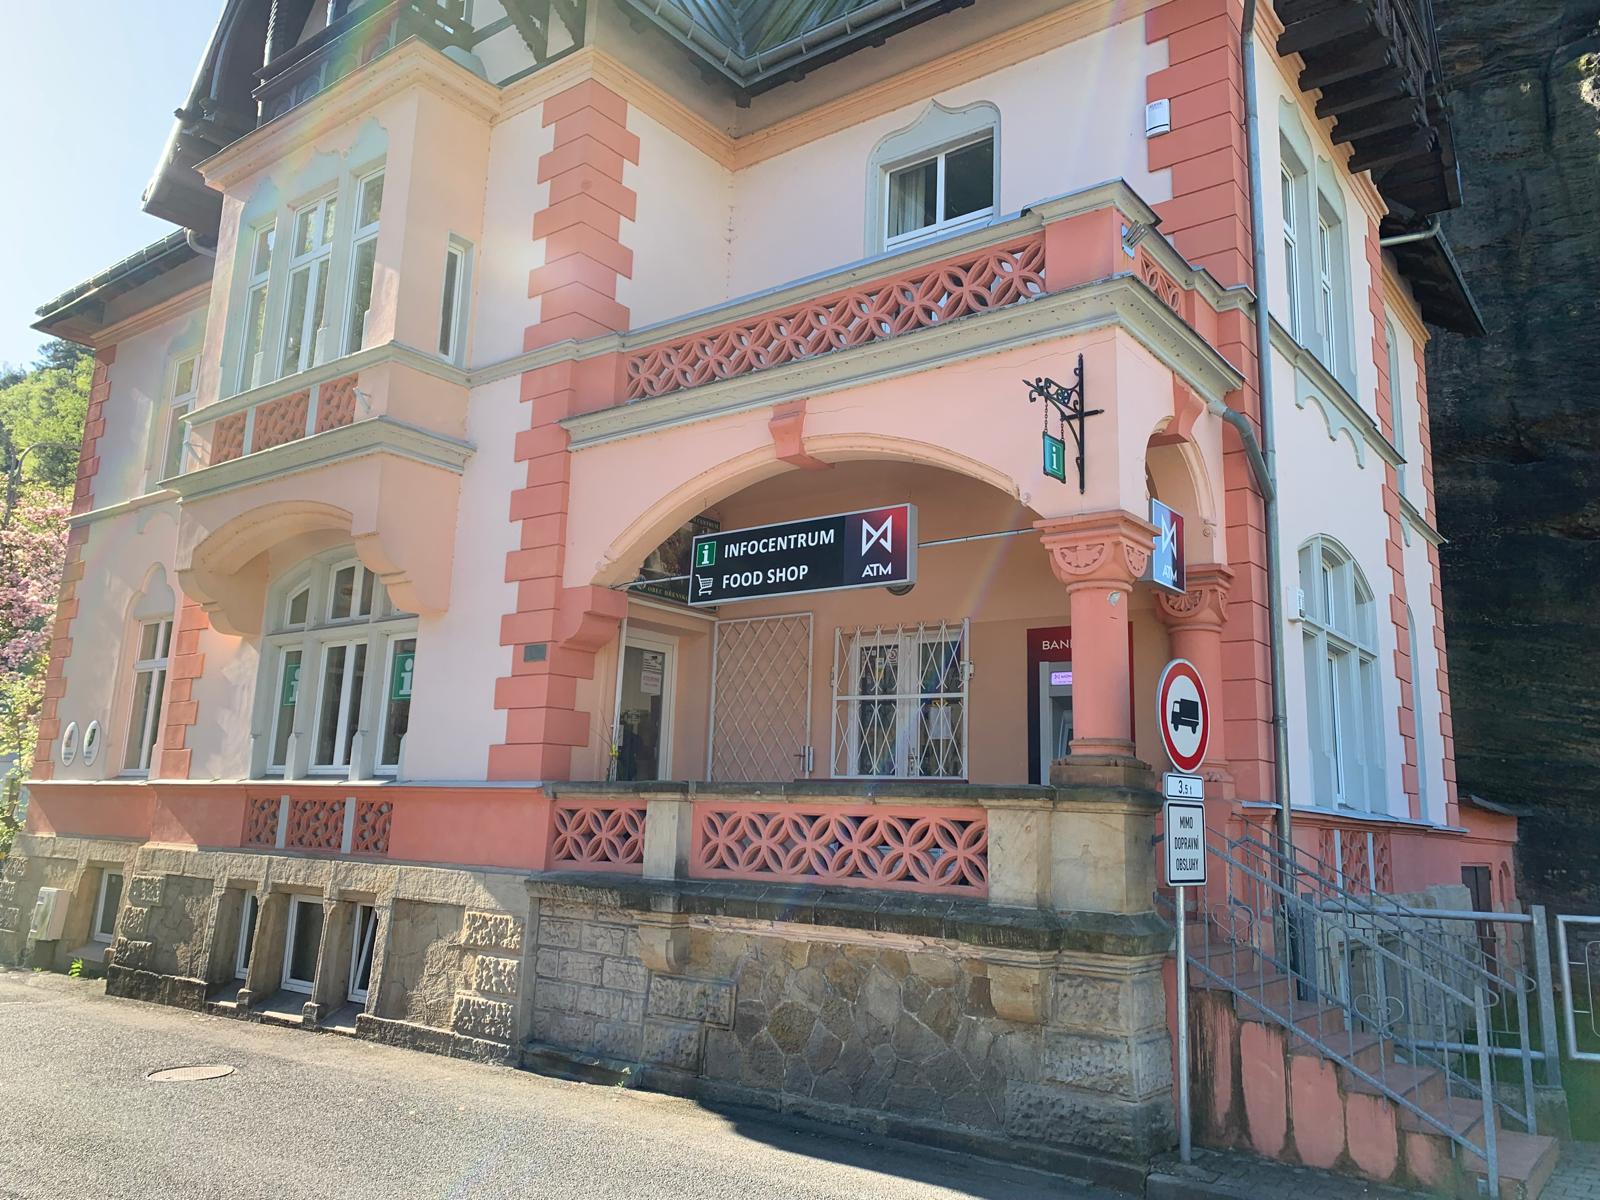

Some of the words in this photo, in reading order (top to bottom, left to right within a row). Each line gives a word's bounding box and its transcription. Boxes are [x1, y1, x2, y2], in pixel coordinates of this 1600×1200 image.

[724, 529, 835, 558] INFOCENTRUM
[722, 571, 763, 589] FOOD
[766, 564, 809, 584] SHOP
[861, 562, 892, 577] ATM
[1162, 564, 1178, 582] ATM
[1042, 640, 1072, 650] BAN
[1179, 816, 1194, 829] MIMO
[1174, 835, 1199, 850] DOPRAVNÍ
[1175, 858, 1199, 871] OBSLUHY
